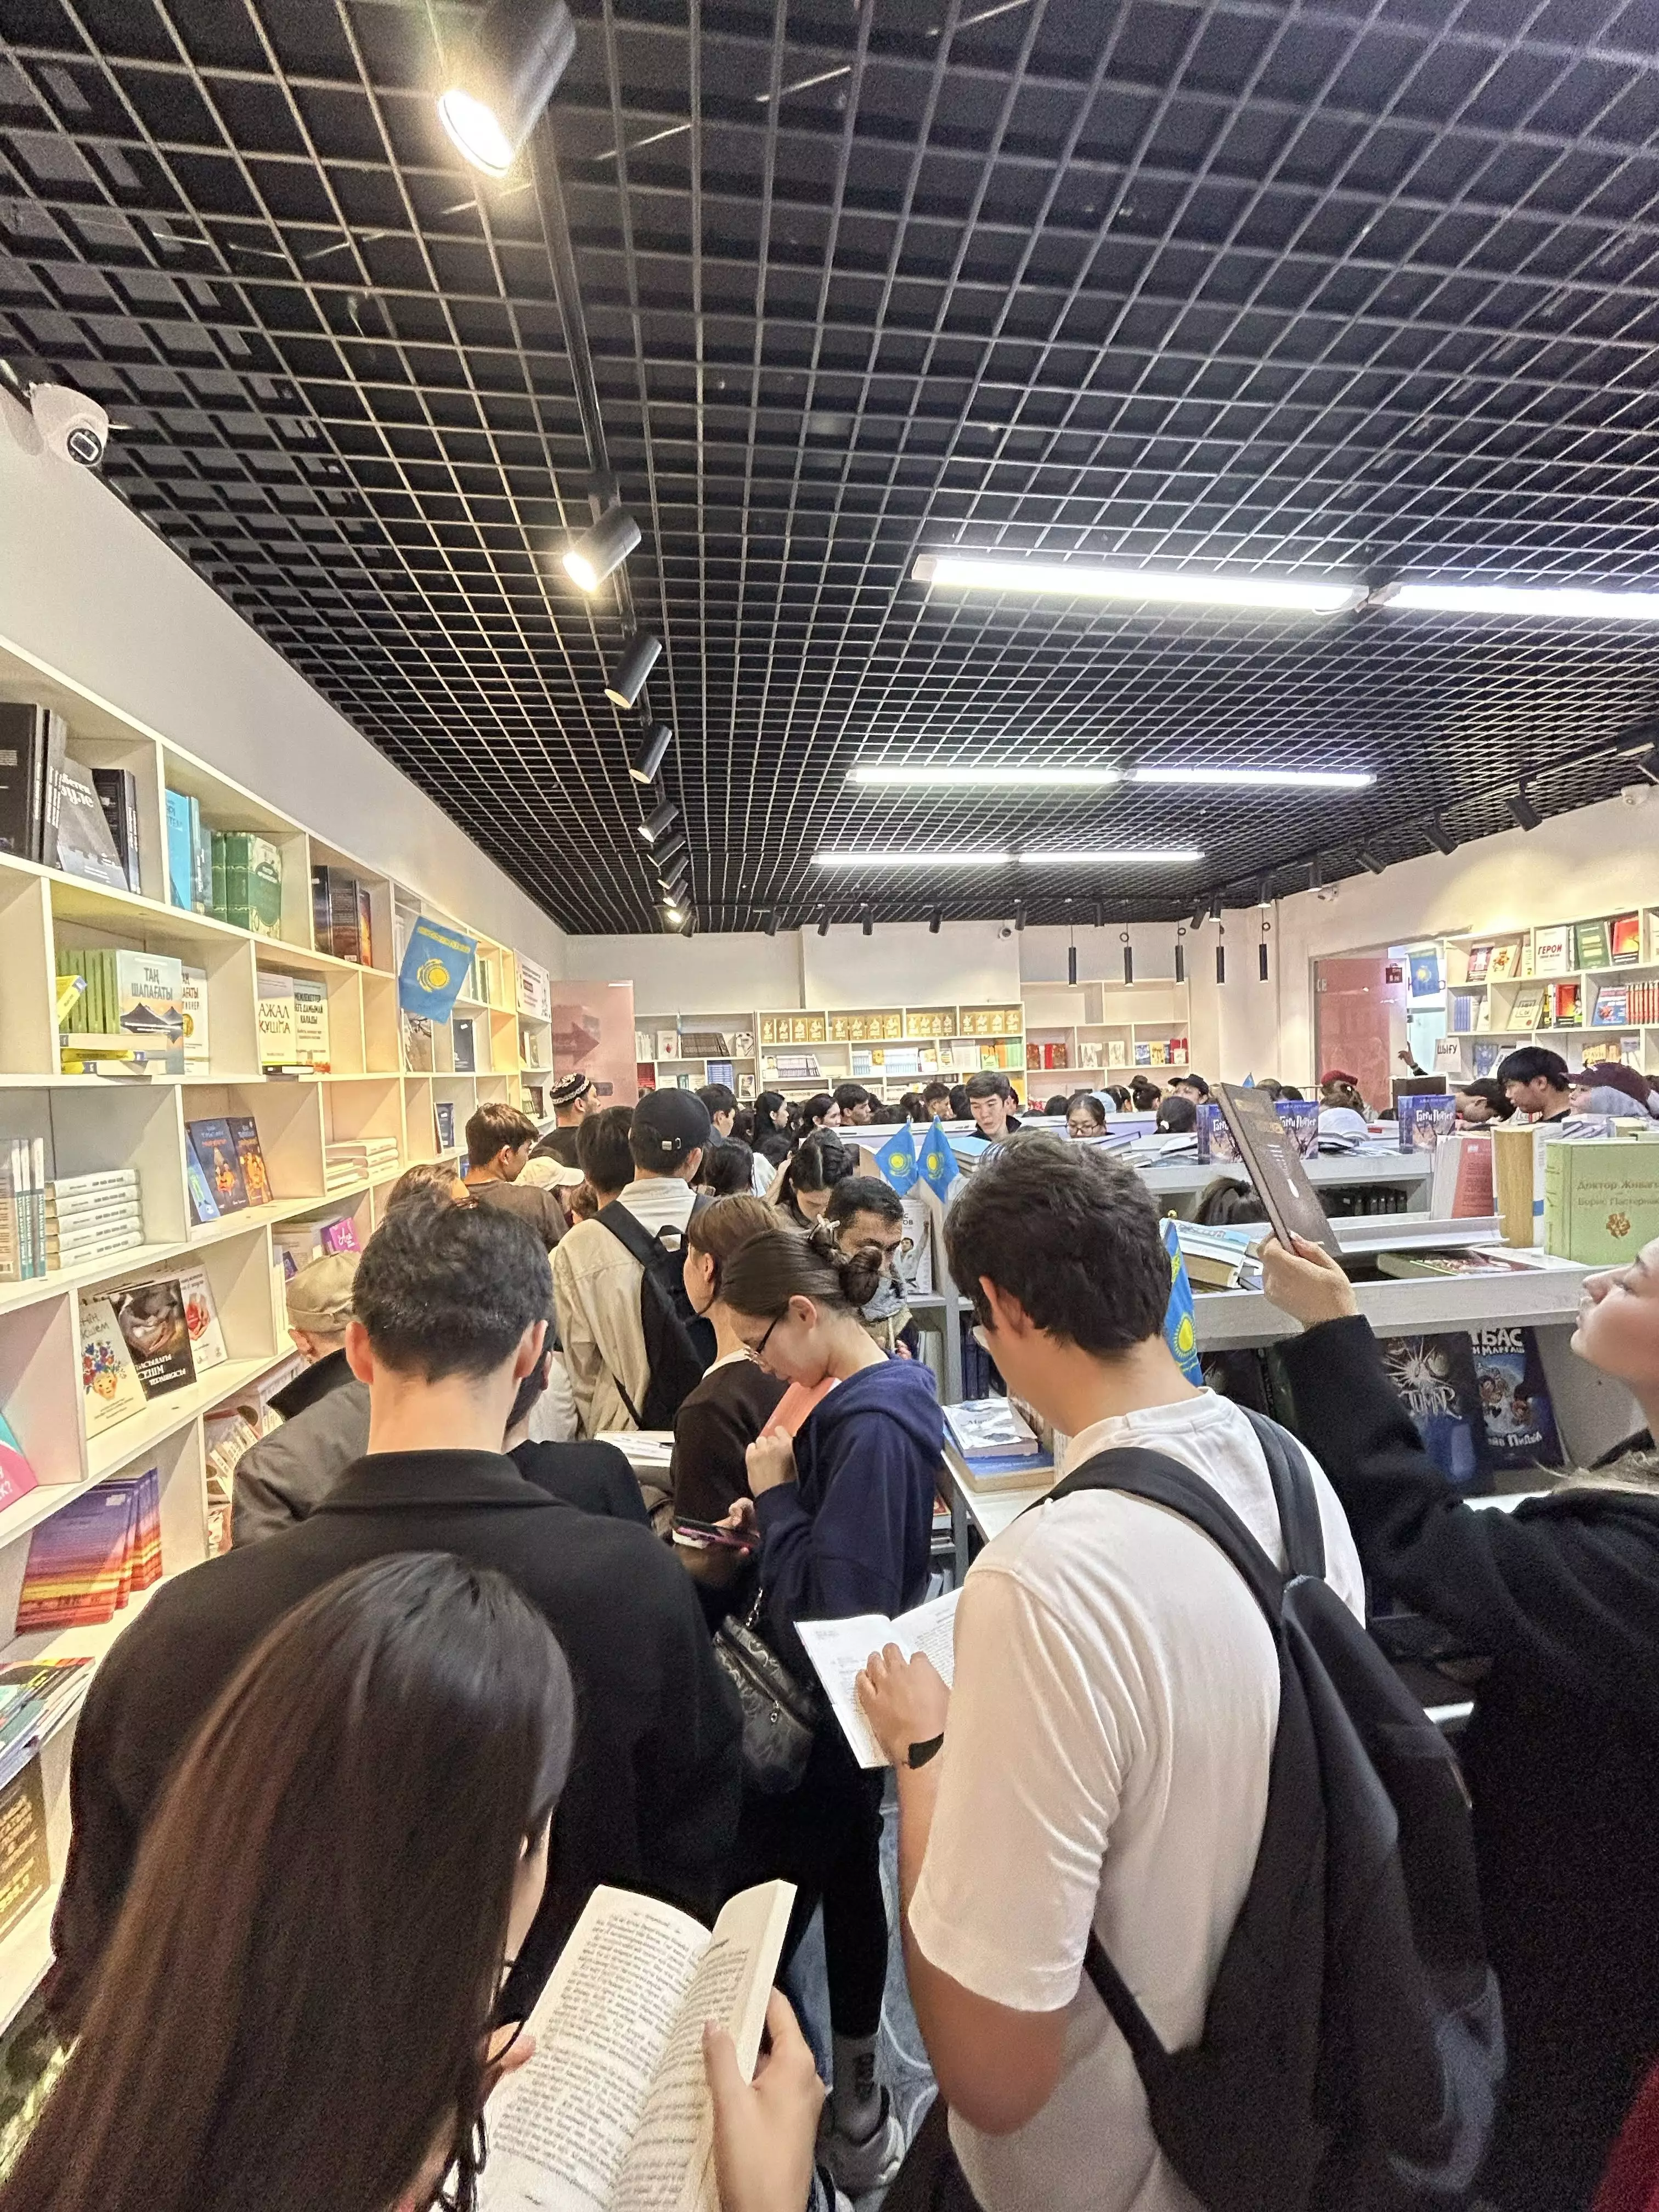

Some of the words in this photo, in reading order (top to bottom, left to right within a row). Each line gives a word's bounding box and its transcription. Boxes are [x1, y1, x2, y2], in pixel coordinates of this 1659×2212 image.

[143, 967, 160, 984] ТАҢ
[181, 972, 190, 986] АҢ
[131, 983, 173, 1001] ШАПАҒАТЫ
[182, 987, 199, 998] АҒАТЫ
[258, 1003, 290, 1019] АЖАЛ
[1437, 1044, 1458, 1054] ШЫҒУ
[1470, 1327, 1523, 1346] ТБАС
